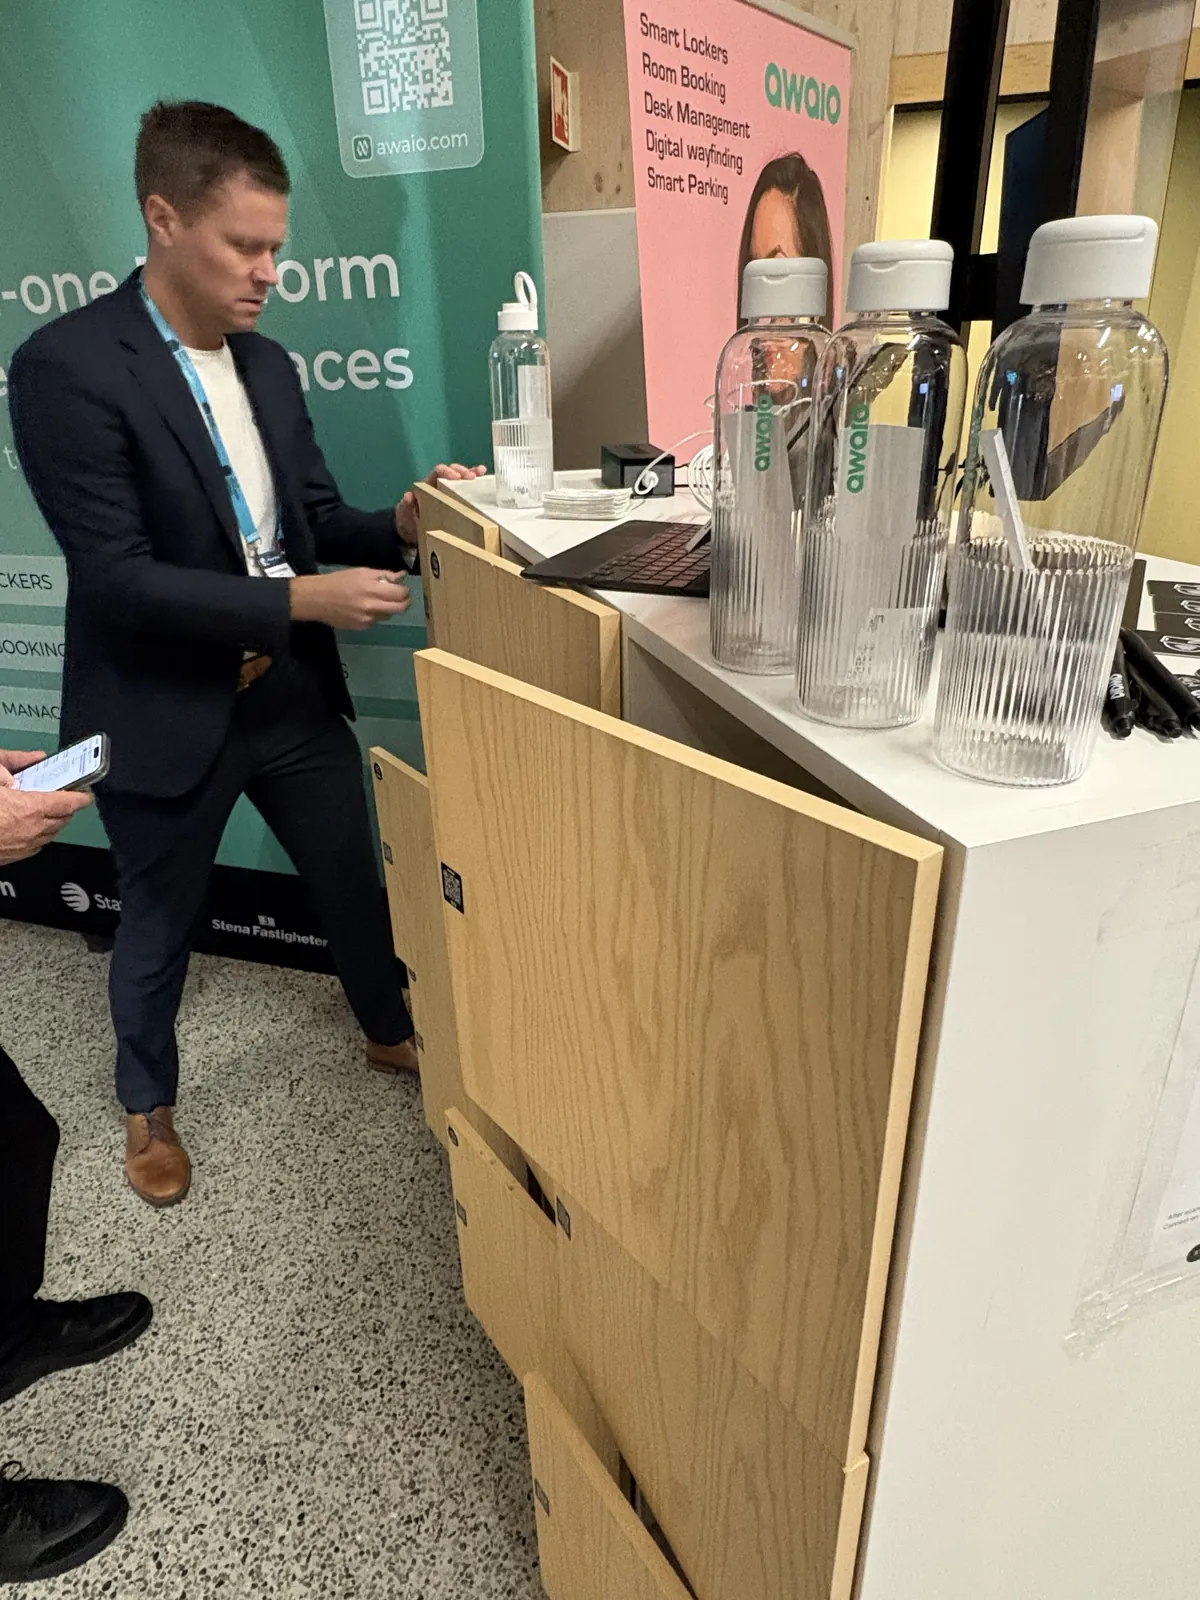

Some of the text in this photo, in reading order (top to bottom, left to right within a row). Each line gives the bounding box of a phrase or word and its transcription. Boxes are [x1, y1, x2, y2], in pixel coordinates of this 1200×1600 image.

[640, 13, 729, 65] Smart Lockers
[642, 52, 726, 105] Room Booking
[764, 62, 841, 125] awaio
[644, 91, 750, 139] Desk Management
[376, 133, 469, 155] awaio.com
[646, 129, 743, 175] Digital wayfinding
[647, 166, 729, 205] Smart Parking
[276, 253, 400, 303] orm
[754, 394, 773, 472] awaio
[846, 403, 870, 494] awaio
[211, 918, 329, 948] Stena Fastigheter
